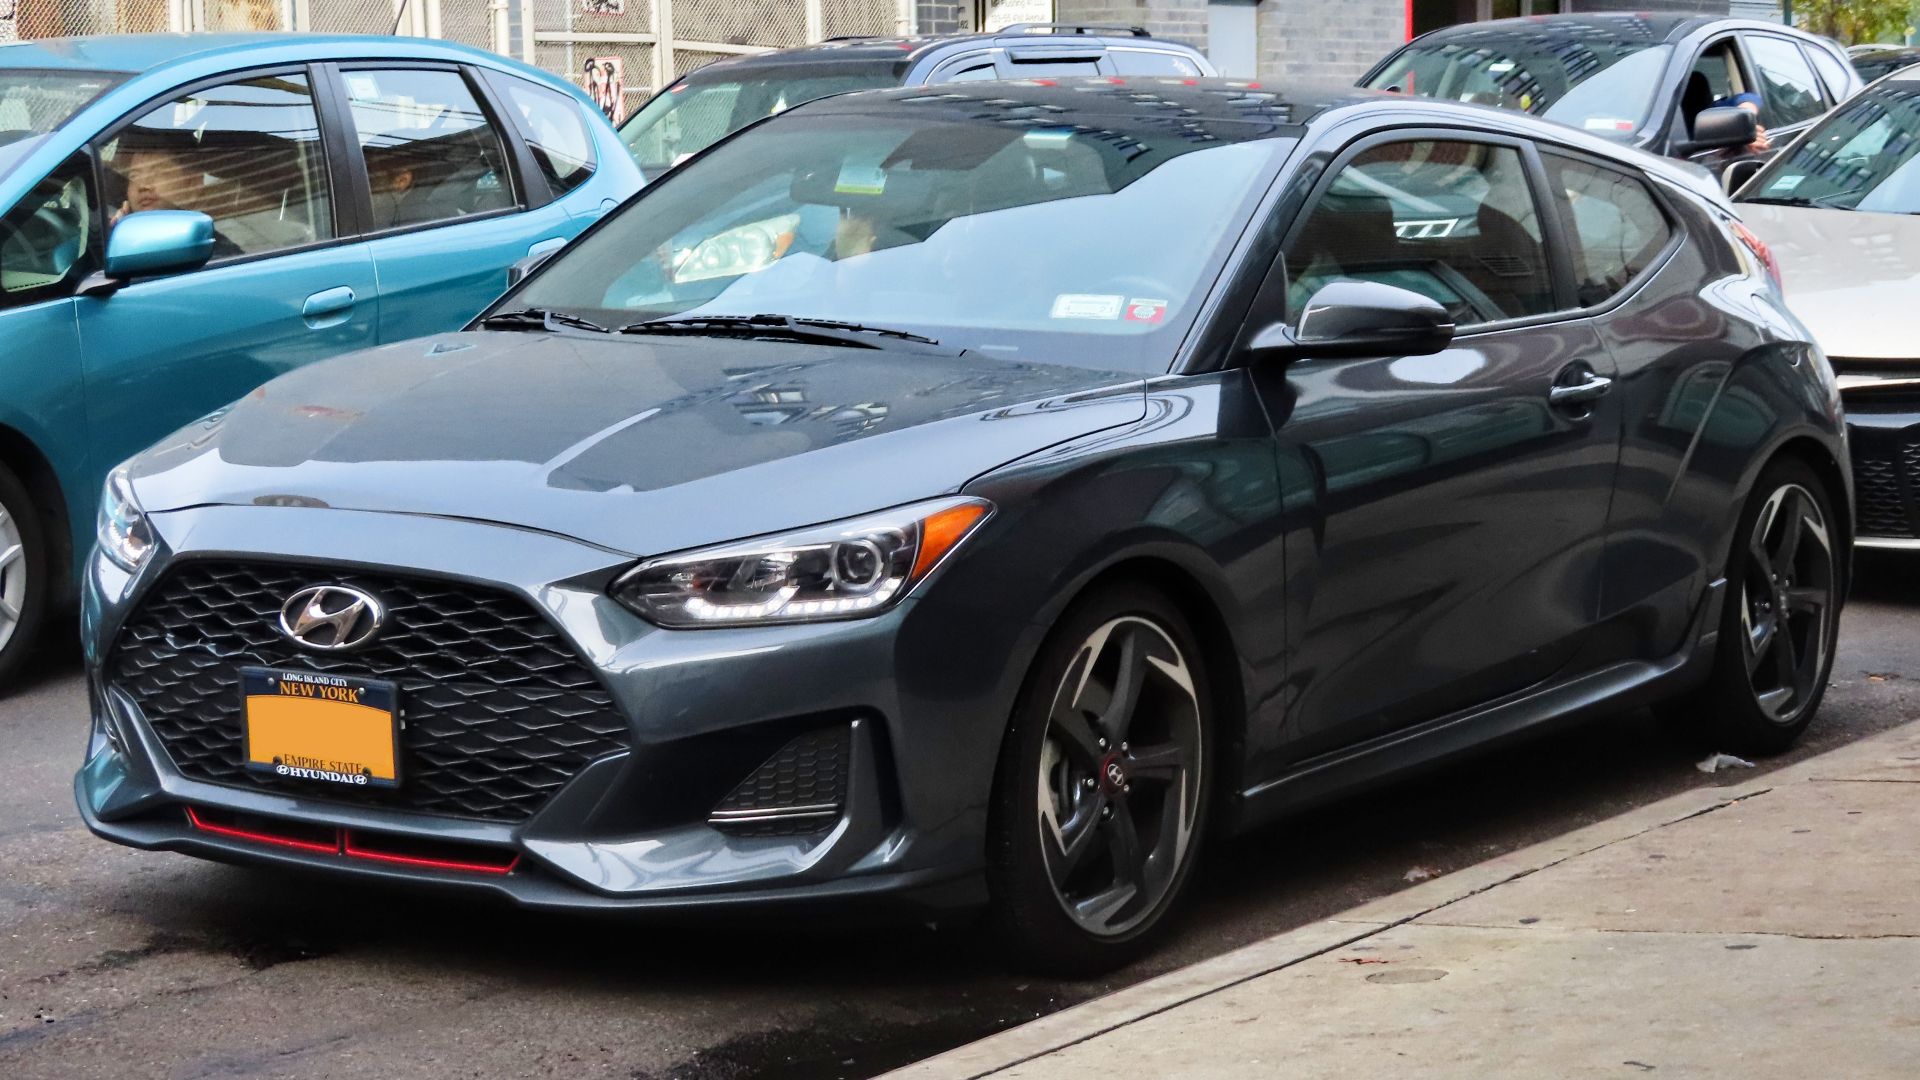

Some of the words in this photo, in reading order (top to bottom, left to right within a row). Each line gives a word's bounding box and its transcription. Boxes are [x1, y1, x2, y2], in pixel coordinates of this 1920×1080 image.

[282, 673, 304, 682] LONG
[304, 674, 329, 685] ISLAND
[330, 678, 348, 687] CITY
[280, 681, 315, 697] NEW
[319, 685, 359, 703] YORK
[284, 753, 326, 769] EMPIRE
[329, 760, 362, 774] STATE
[289, 766, 355, 784] HYUNDAI
